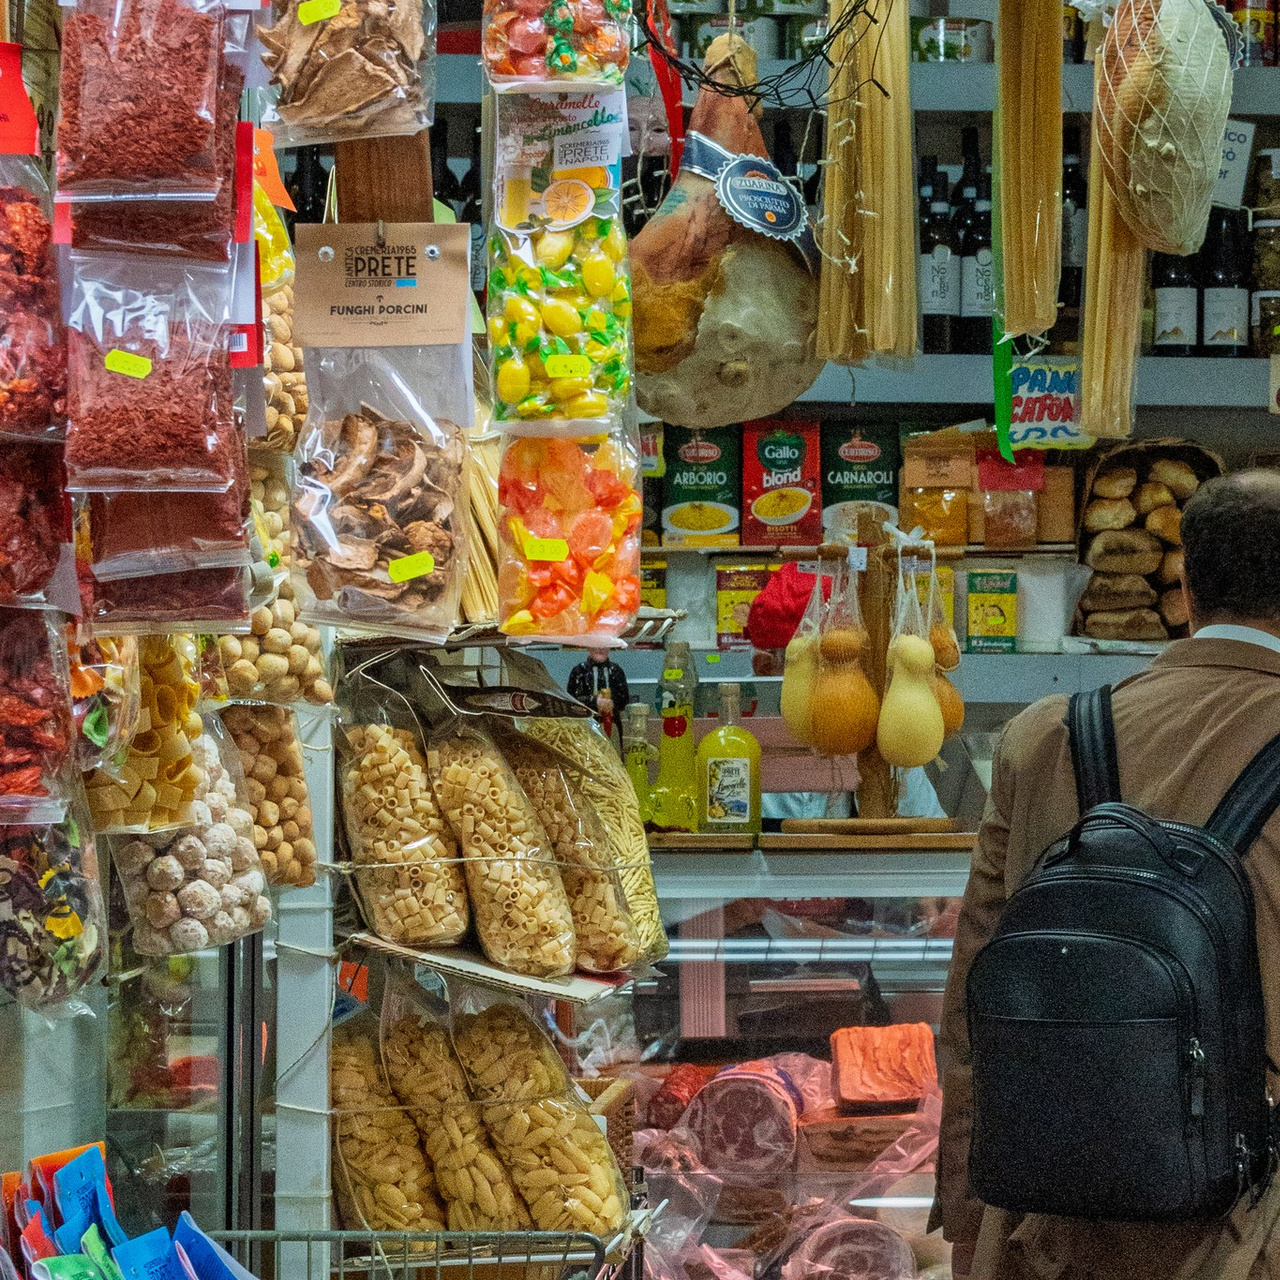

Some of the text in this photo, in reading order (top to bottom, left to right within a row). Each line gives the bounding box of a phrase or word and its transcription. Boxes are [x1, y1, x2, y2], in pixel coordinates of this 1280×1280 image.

[563, 146, 608, 159] PRETE
[354, 245, 417, 256] CREMERIA1965
[354, 256, 417, 277] PRETE
[330, 304, 428, 316] FUNGHI PORCINI
[764, 445, 799, 459] Gallo
[673, 471, 728, 486] ARBORIO
[762, 469, 802, 488] blond
[827, 470, 893, 485] CARNAROLI
